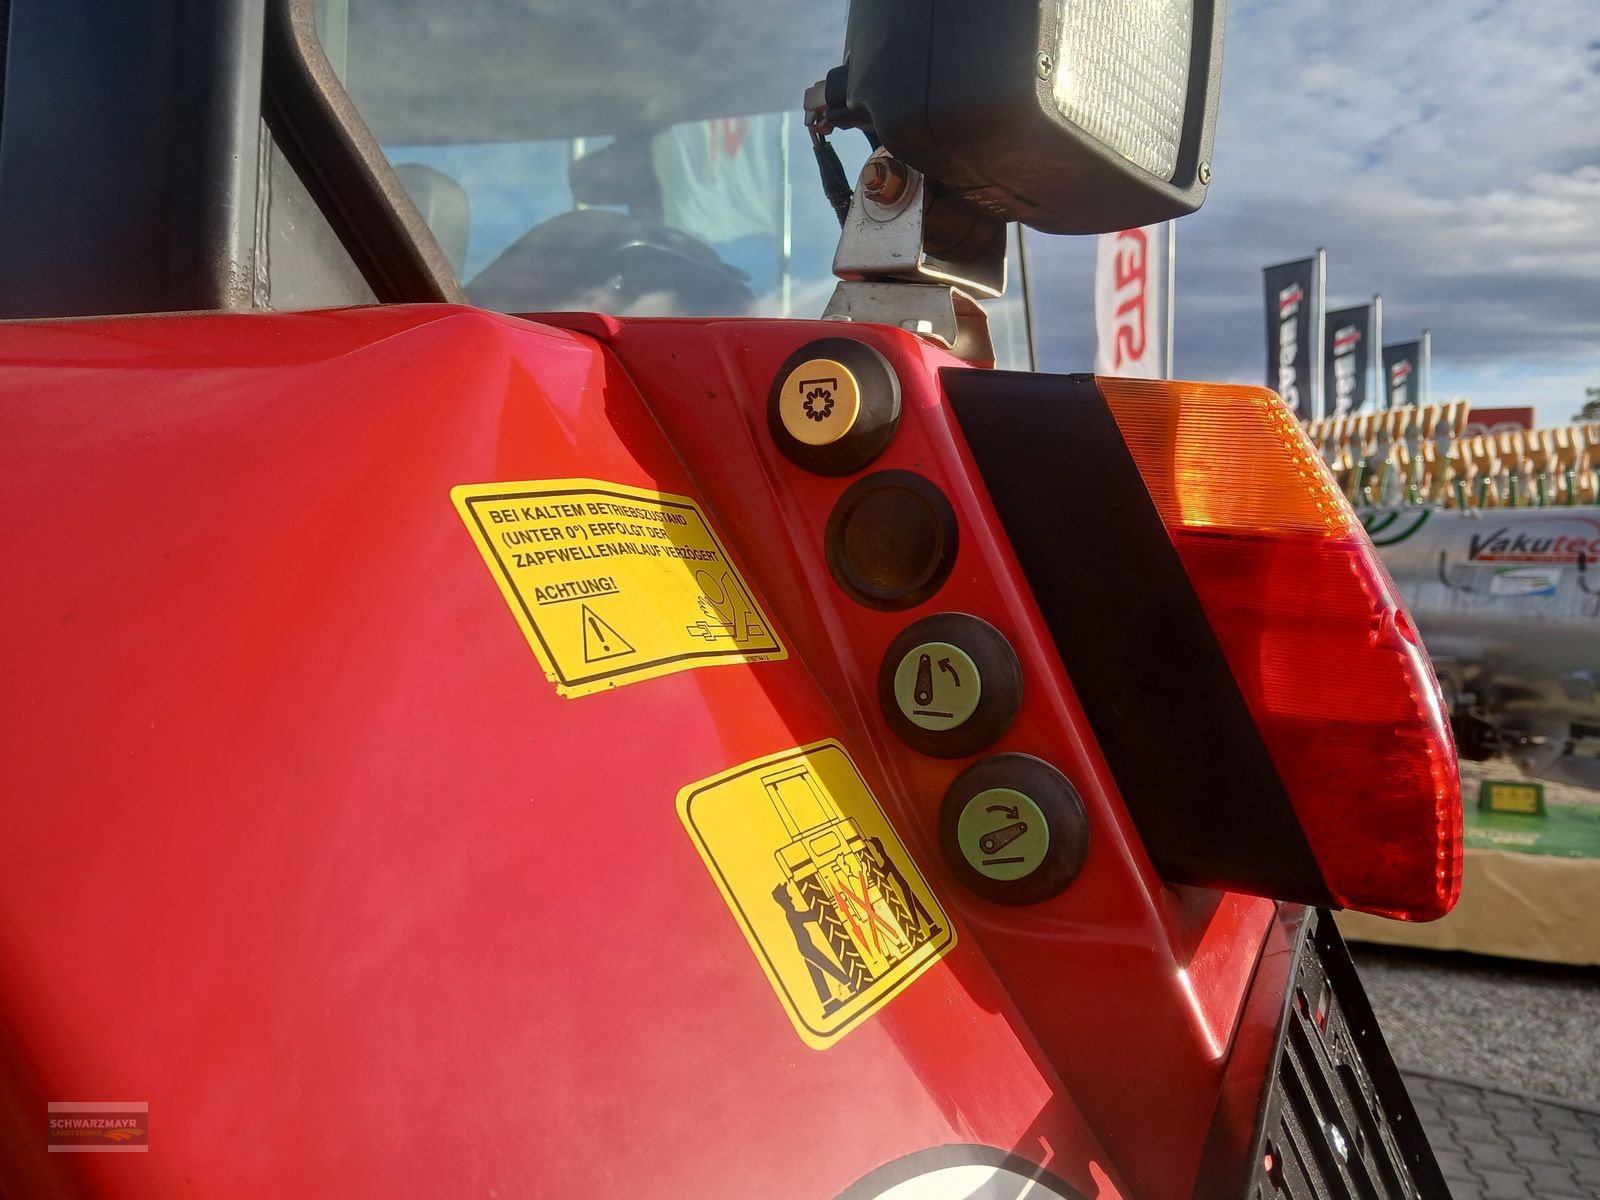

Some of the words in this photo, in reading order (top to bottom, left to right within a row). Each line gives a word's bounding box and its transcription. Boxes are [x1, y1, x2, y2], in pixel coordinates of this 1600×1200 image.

[488, 508, 520, 523] BEI
[521, 503, 586, 520] KALTEM
[586, 502, 688, 525] BETRIEBSZUSTAND
[502, 526, 565, 549] (UNTER
[588, 522, 647, 538] ERFOLGT
[646, 526, 668, 540] DER
[512, 542, 662, 568] ZAPFWELLENANLAUF
[661, 544, 719, 562] VERZÖGERT
[534, 576, 618, 602] ACHTUNG!
